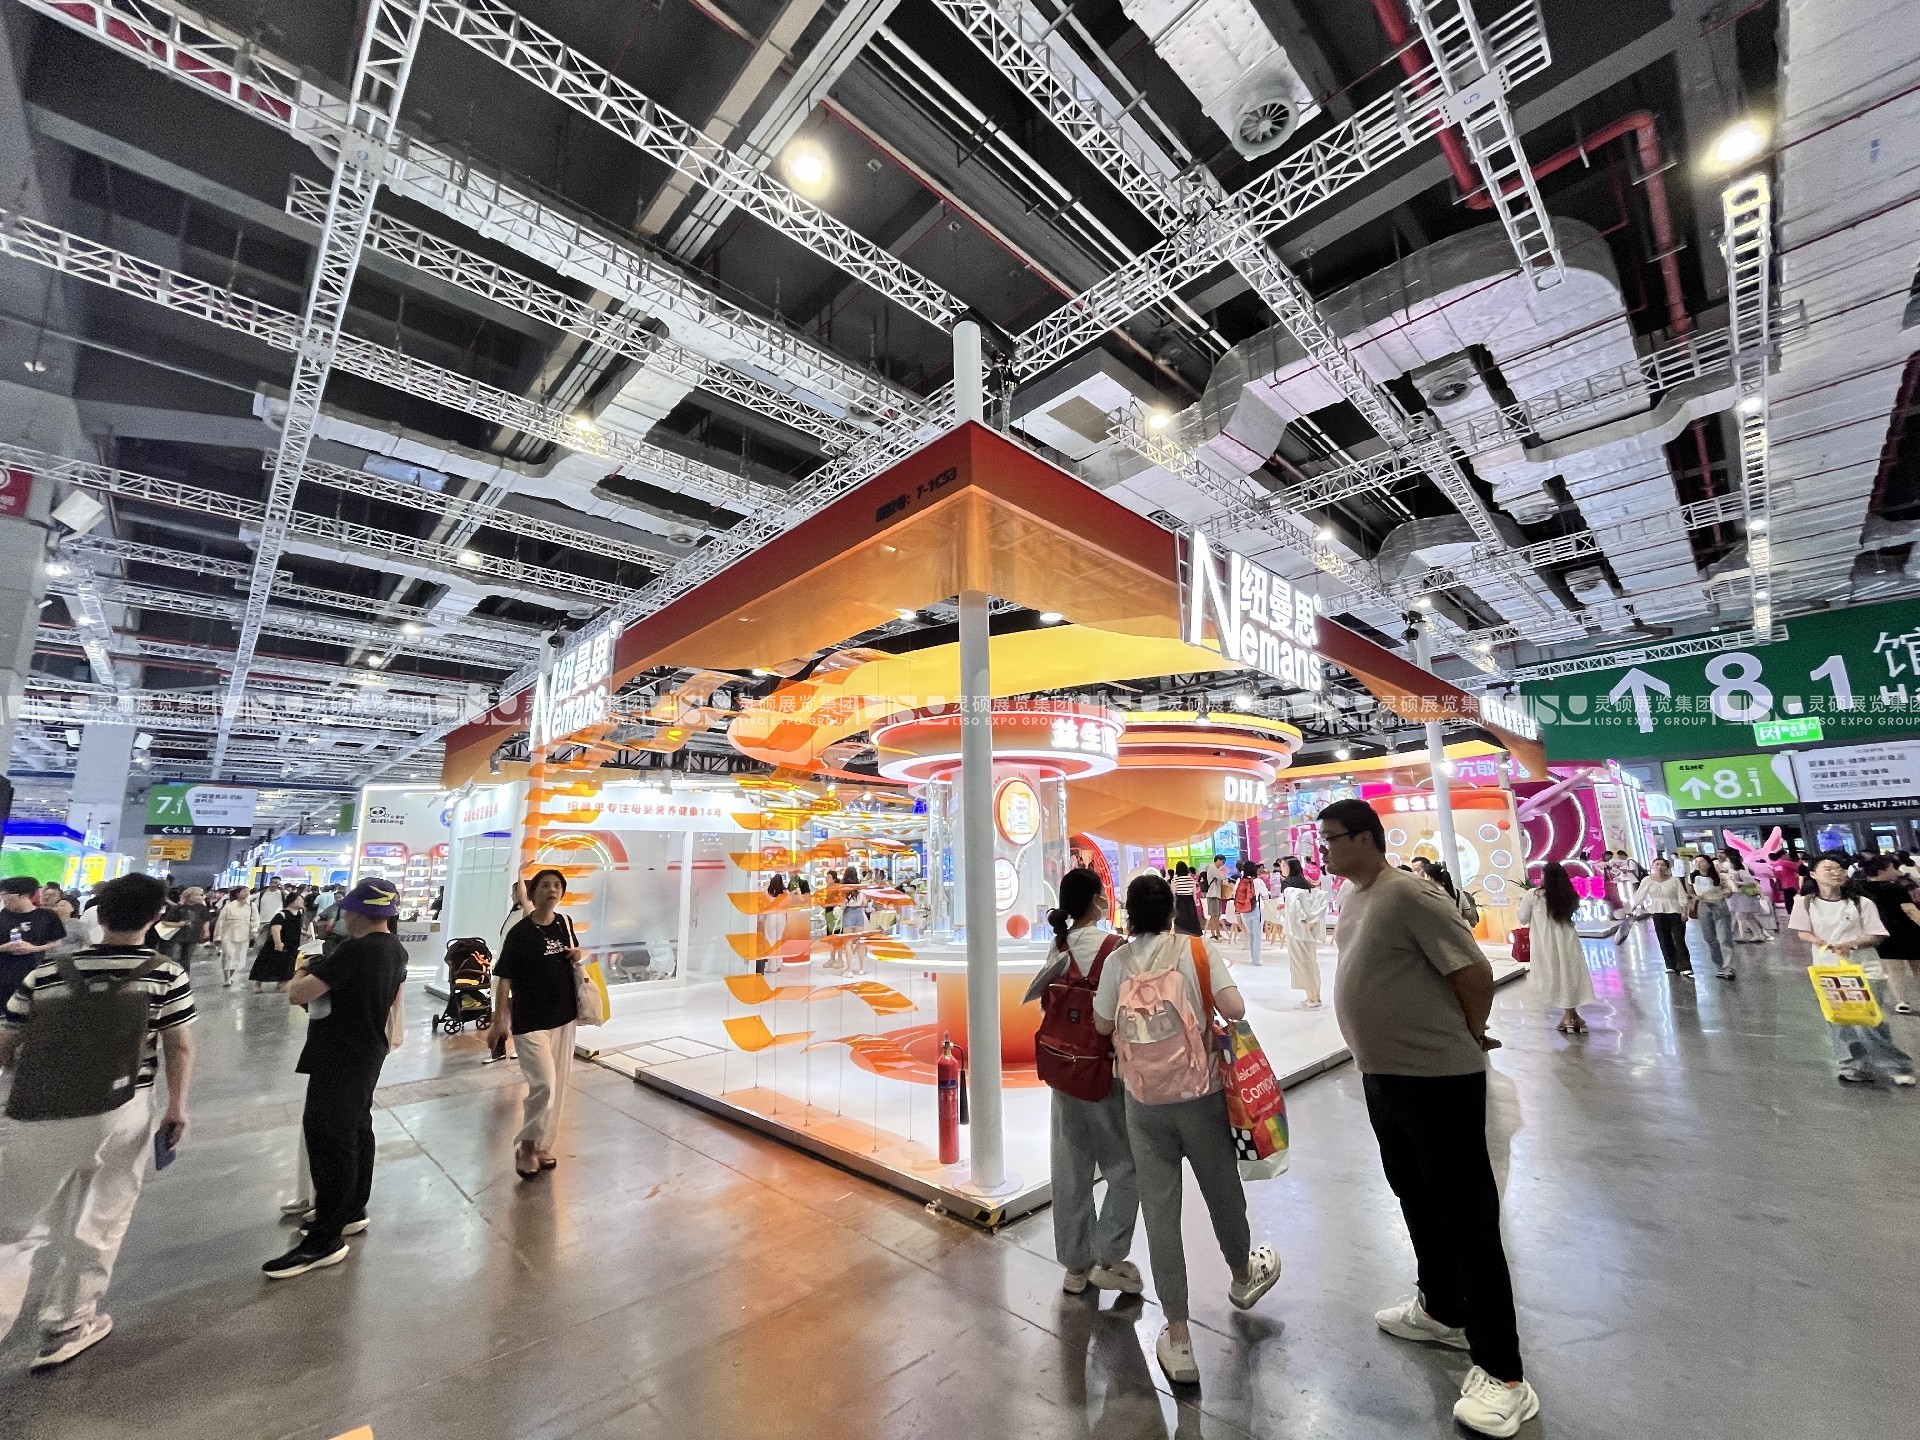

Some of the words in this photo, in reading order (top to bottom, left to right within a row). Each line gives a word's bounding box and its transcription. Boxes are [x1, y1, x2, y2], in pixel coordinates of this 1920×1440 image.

[1190, 530, 1323, 691] Nemans
[1240, 559, 1319, 646] 纽曼思
[1704, 652, 1854, 721] 8.1
[156, 796, 184, 815] 7.1
[1224, 776, 1268, 805] DHA
[1713, 768, 1762, 799] 8.1
